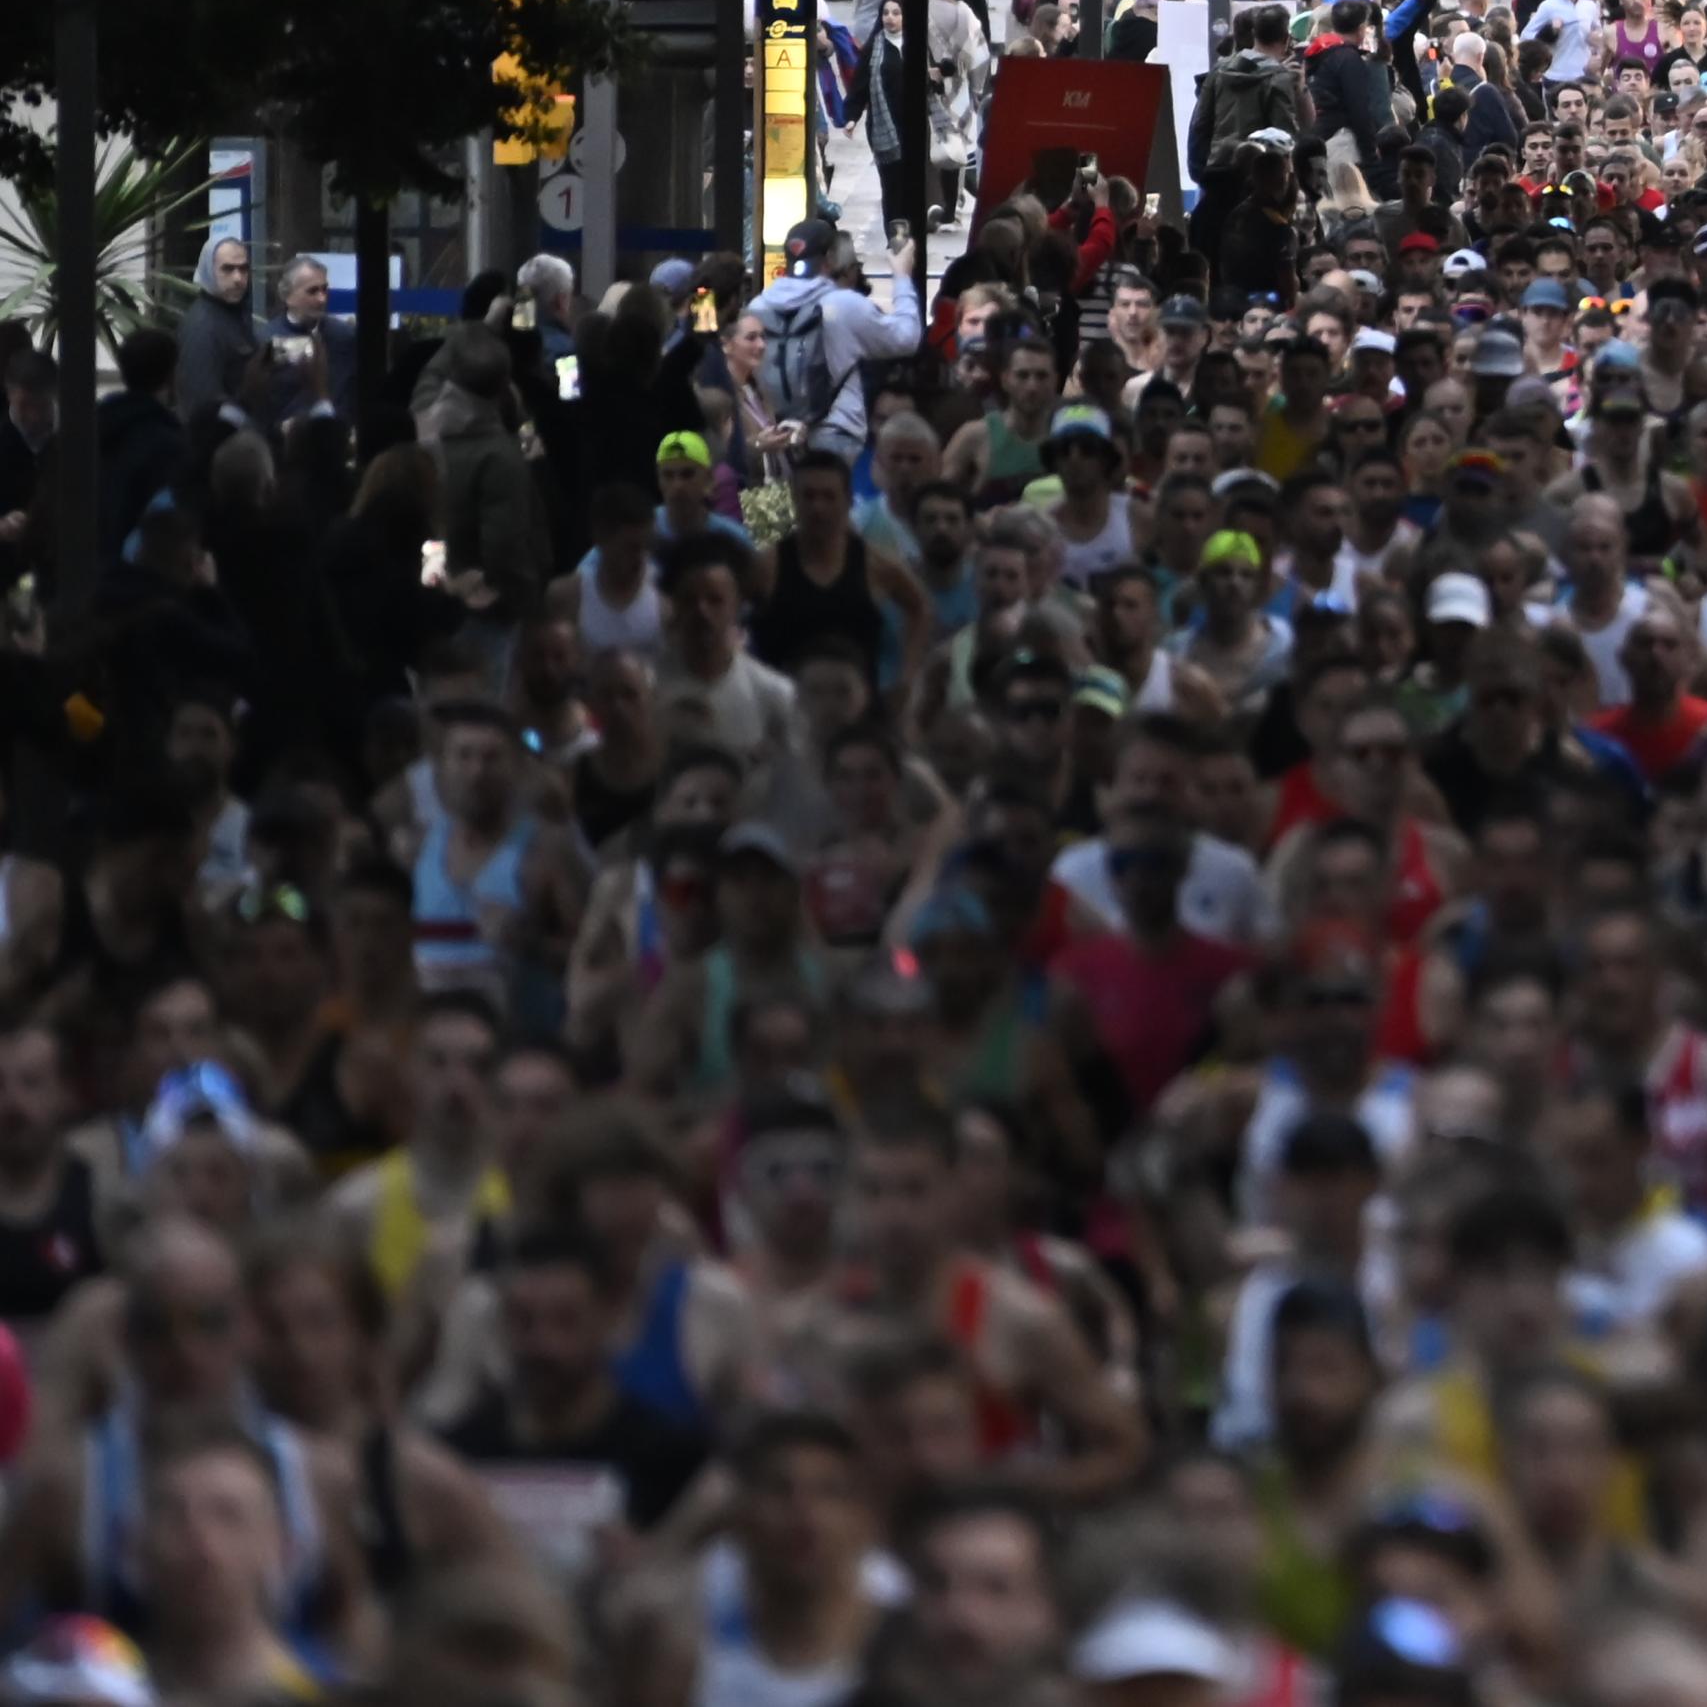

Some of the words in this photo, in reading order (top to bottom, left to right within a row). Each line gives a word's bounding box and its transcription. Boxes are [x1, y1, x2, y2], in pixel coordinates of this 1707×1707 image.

[776, 48, 792, 67] A
[1062, 90, 1093, 109] KM
[557, 188, 573, 219] 1
